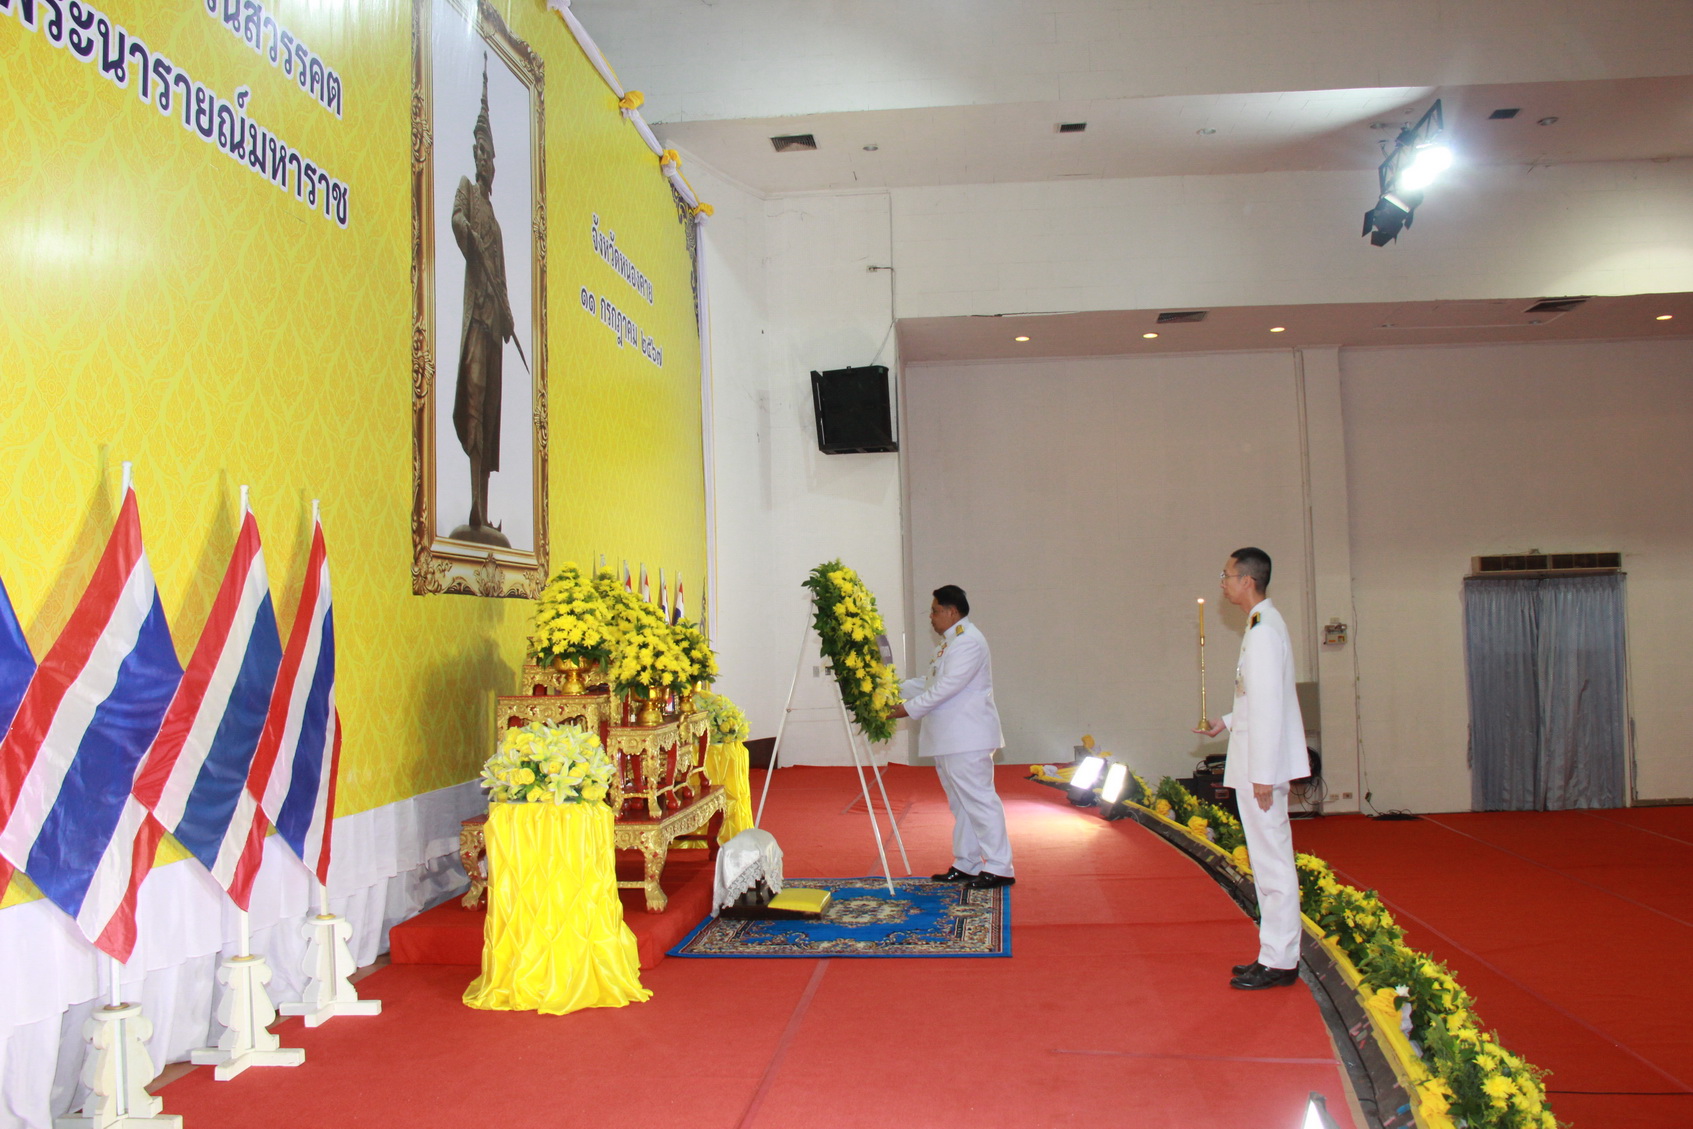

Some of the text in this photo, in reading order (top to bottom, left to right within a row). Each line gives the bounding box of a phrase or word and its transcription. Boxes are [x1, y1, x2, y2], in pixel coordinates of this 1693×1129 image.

[206, 0, 342, 117] นสวรรคต
[591, 213, 654, 304] จังหวัดหนองคาย
[580, 287, 596, 315] ๑๑
[600, 296, 638, 347] กรกฎาคม
